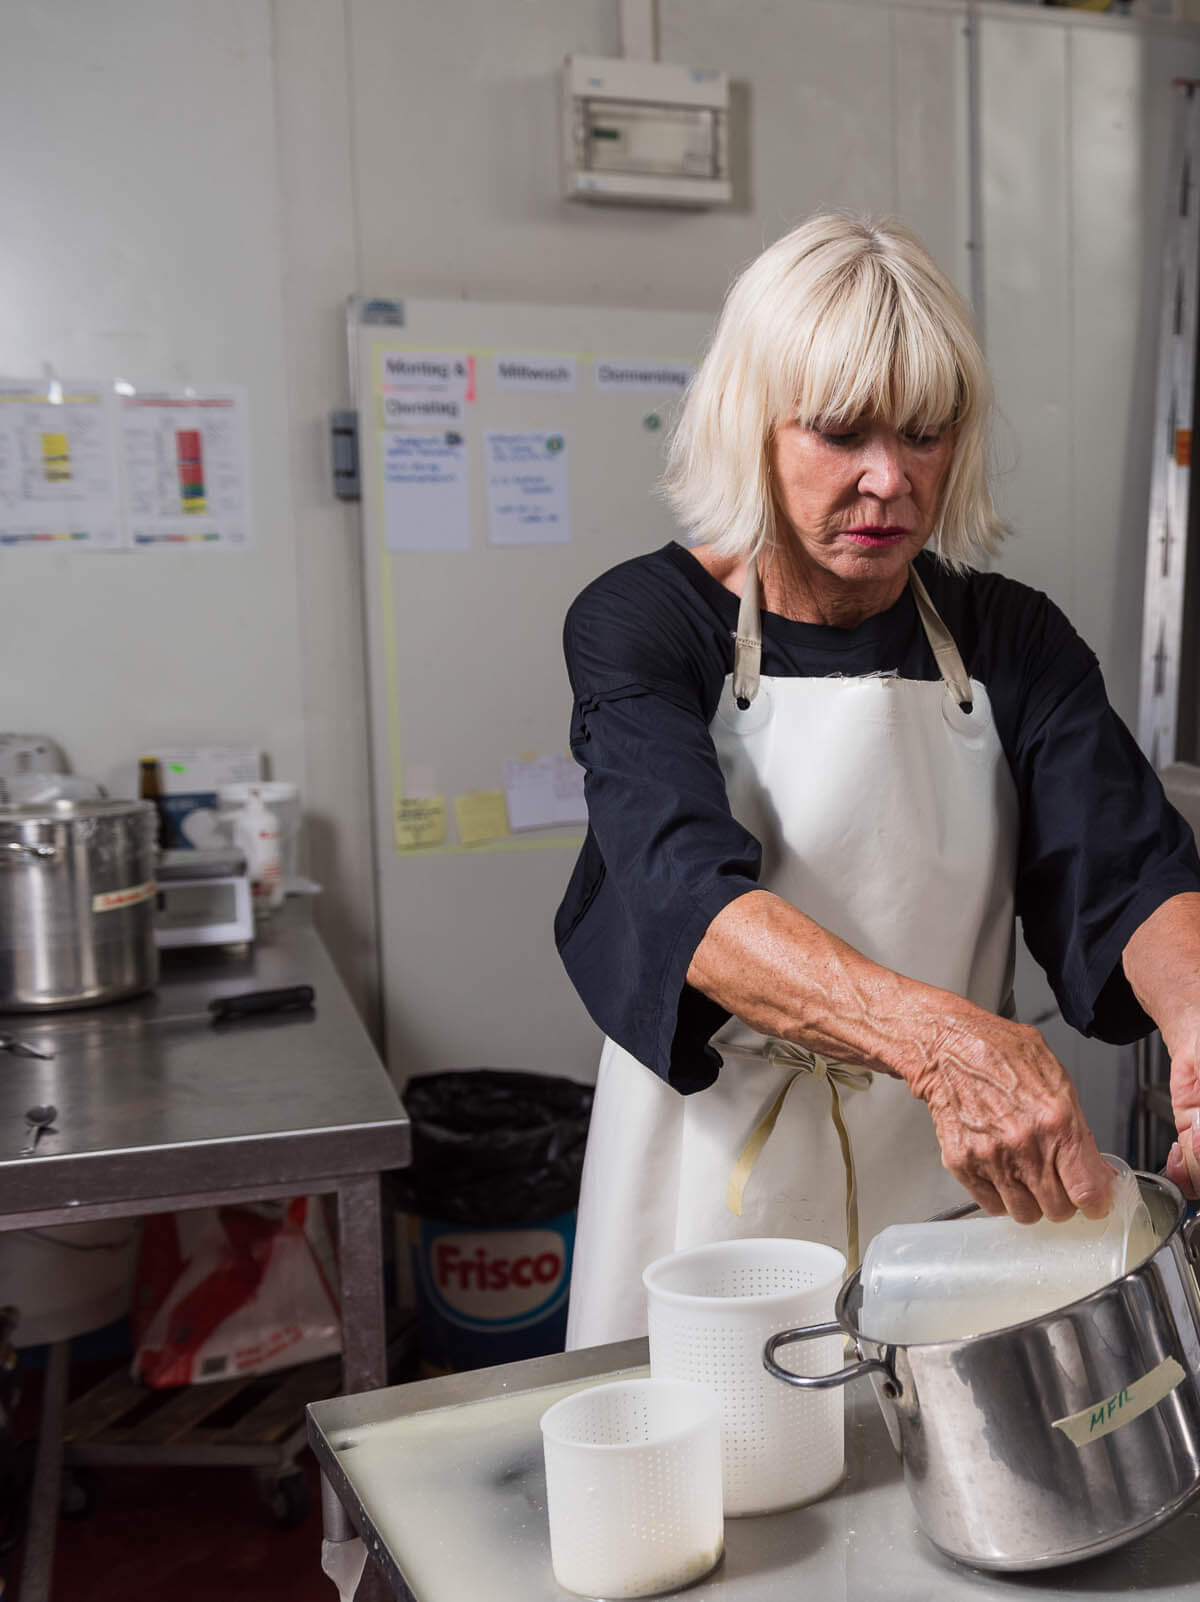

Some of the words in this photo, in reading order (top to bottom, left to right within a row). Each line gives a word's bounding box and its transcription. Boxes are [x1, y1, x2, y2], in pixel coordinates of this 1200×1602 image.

[386, 359, 448, 378] Montag
[498, 363, 570, 381] Mittwoch
[437, 1244, 561, 1292] Frisco
